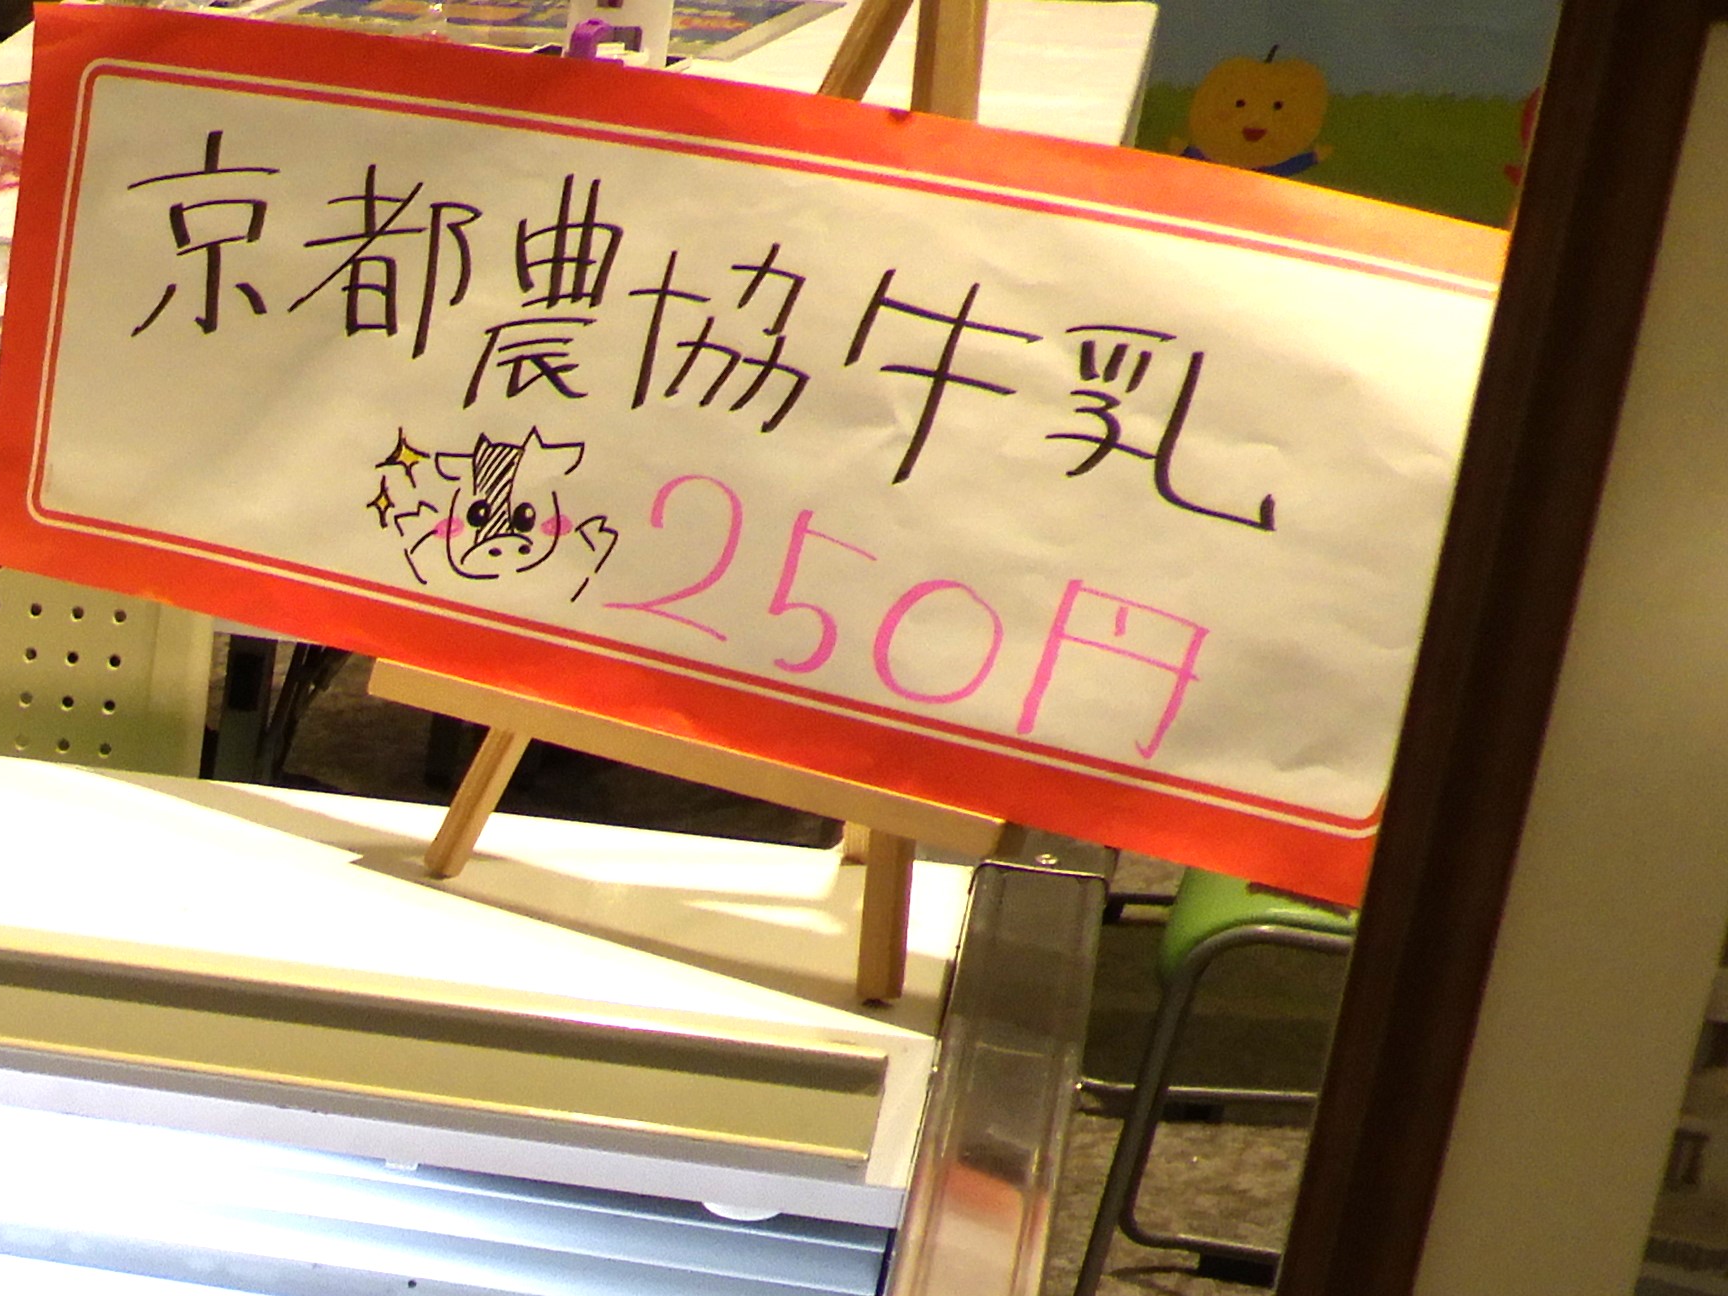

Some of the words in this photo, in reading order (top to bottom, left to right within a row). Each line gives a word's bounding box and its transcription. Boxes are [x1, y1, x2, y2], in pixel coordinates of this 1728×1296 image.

[129, 132, 1278, 534] 京都農協牛乳
[603, 473, 1210, 761] 250円
